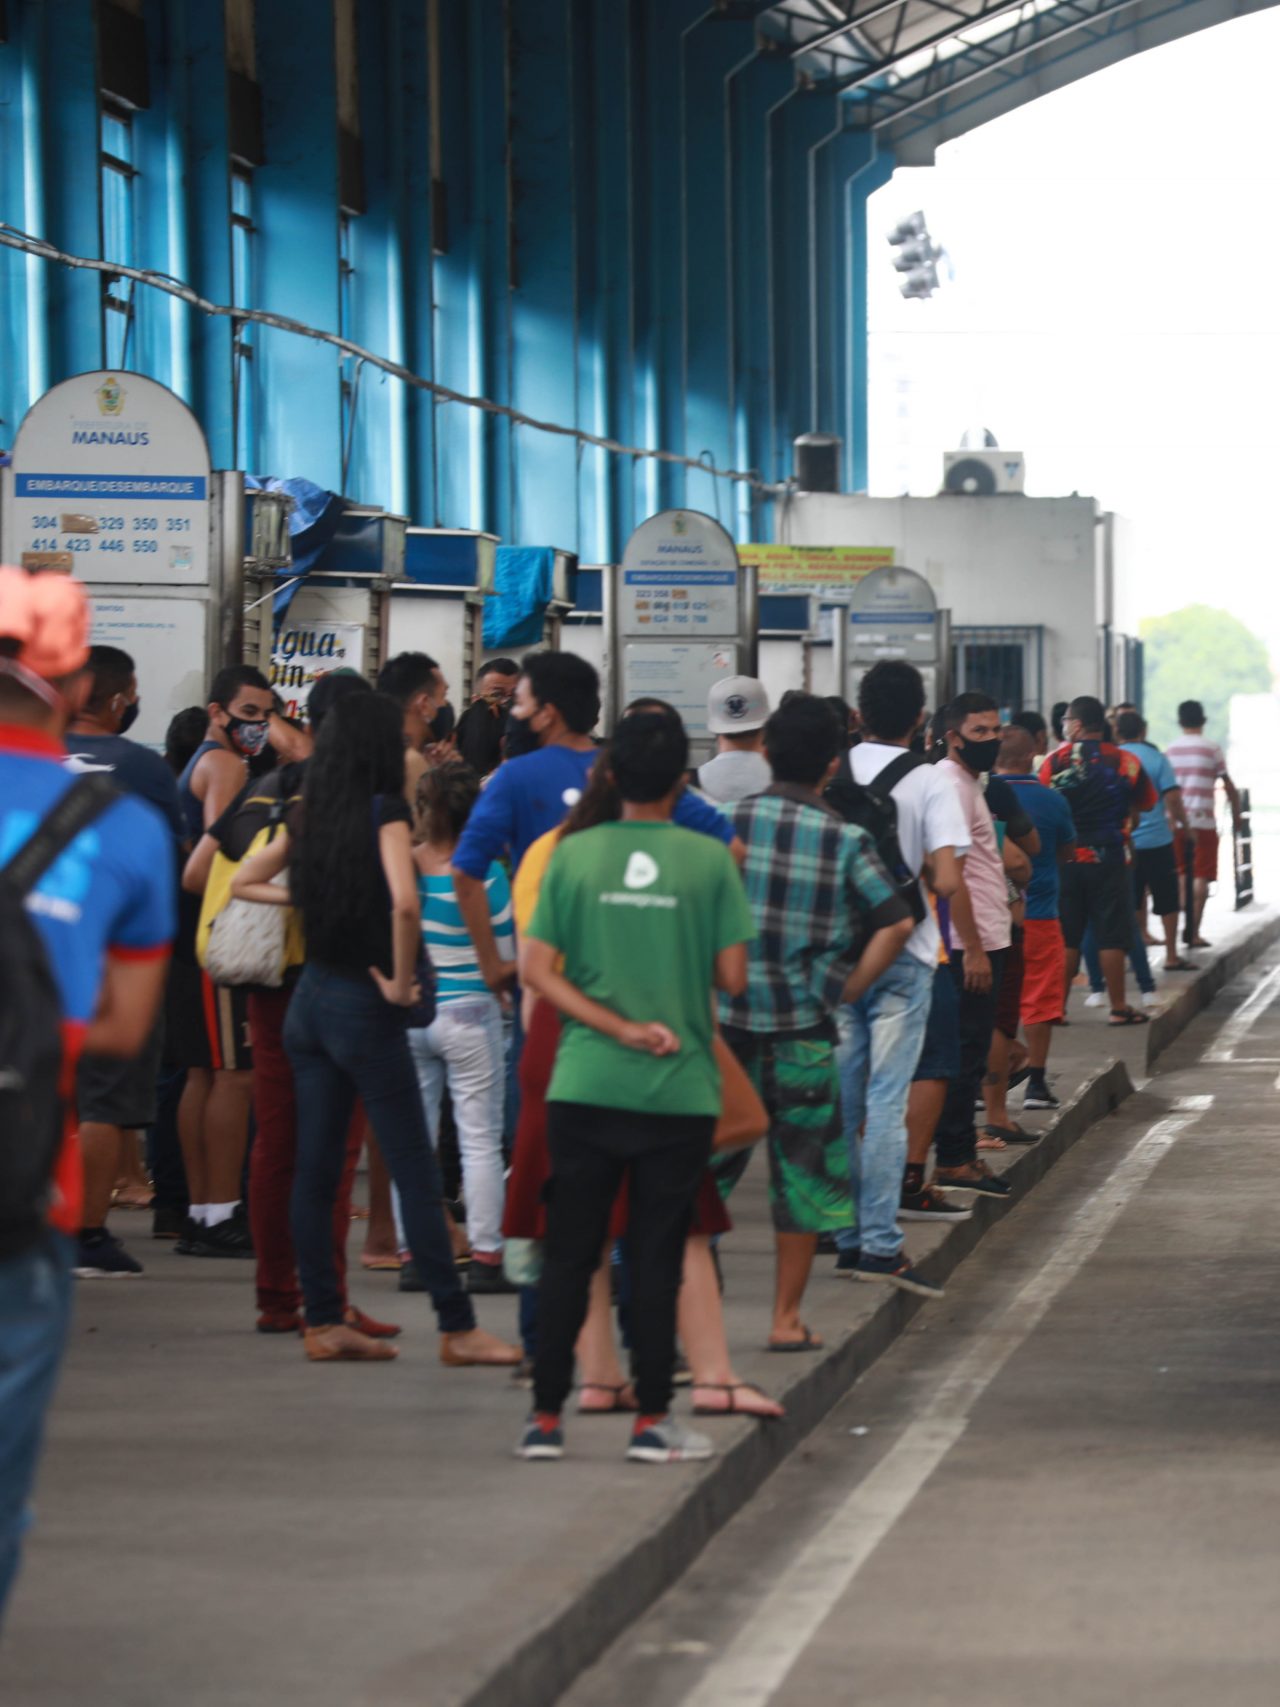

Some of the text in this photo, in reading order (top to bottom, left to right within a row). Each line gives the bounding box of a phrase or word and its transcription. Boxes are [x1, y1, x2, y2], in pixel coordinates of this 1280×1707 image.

[72, 431, 150, 446] MANAUS
[32, 515, 190, 531] 304 329 350 351
[31, 538, 158, 553] 414 423 446 550
